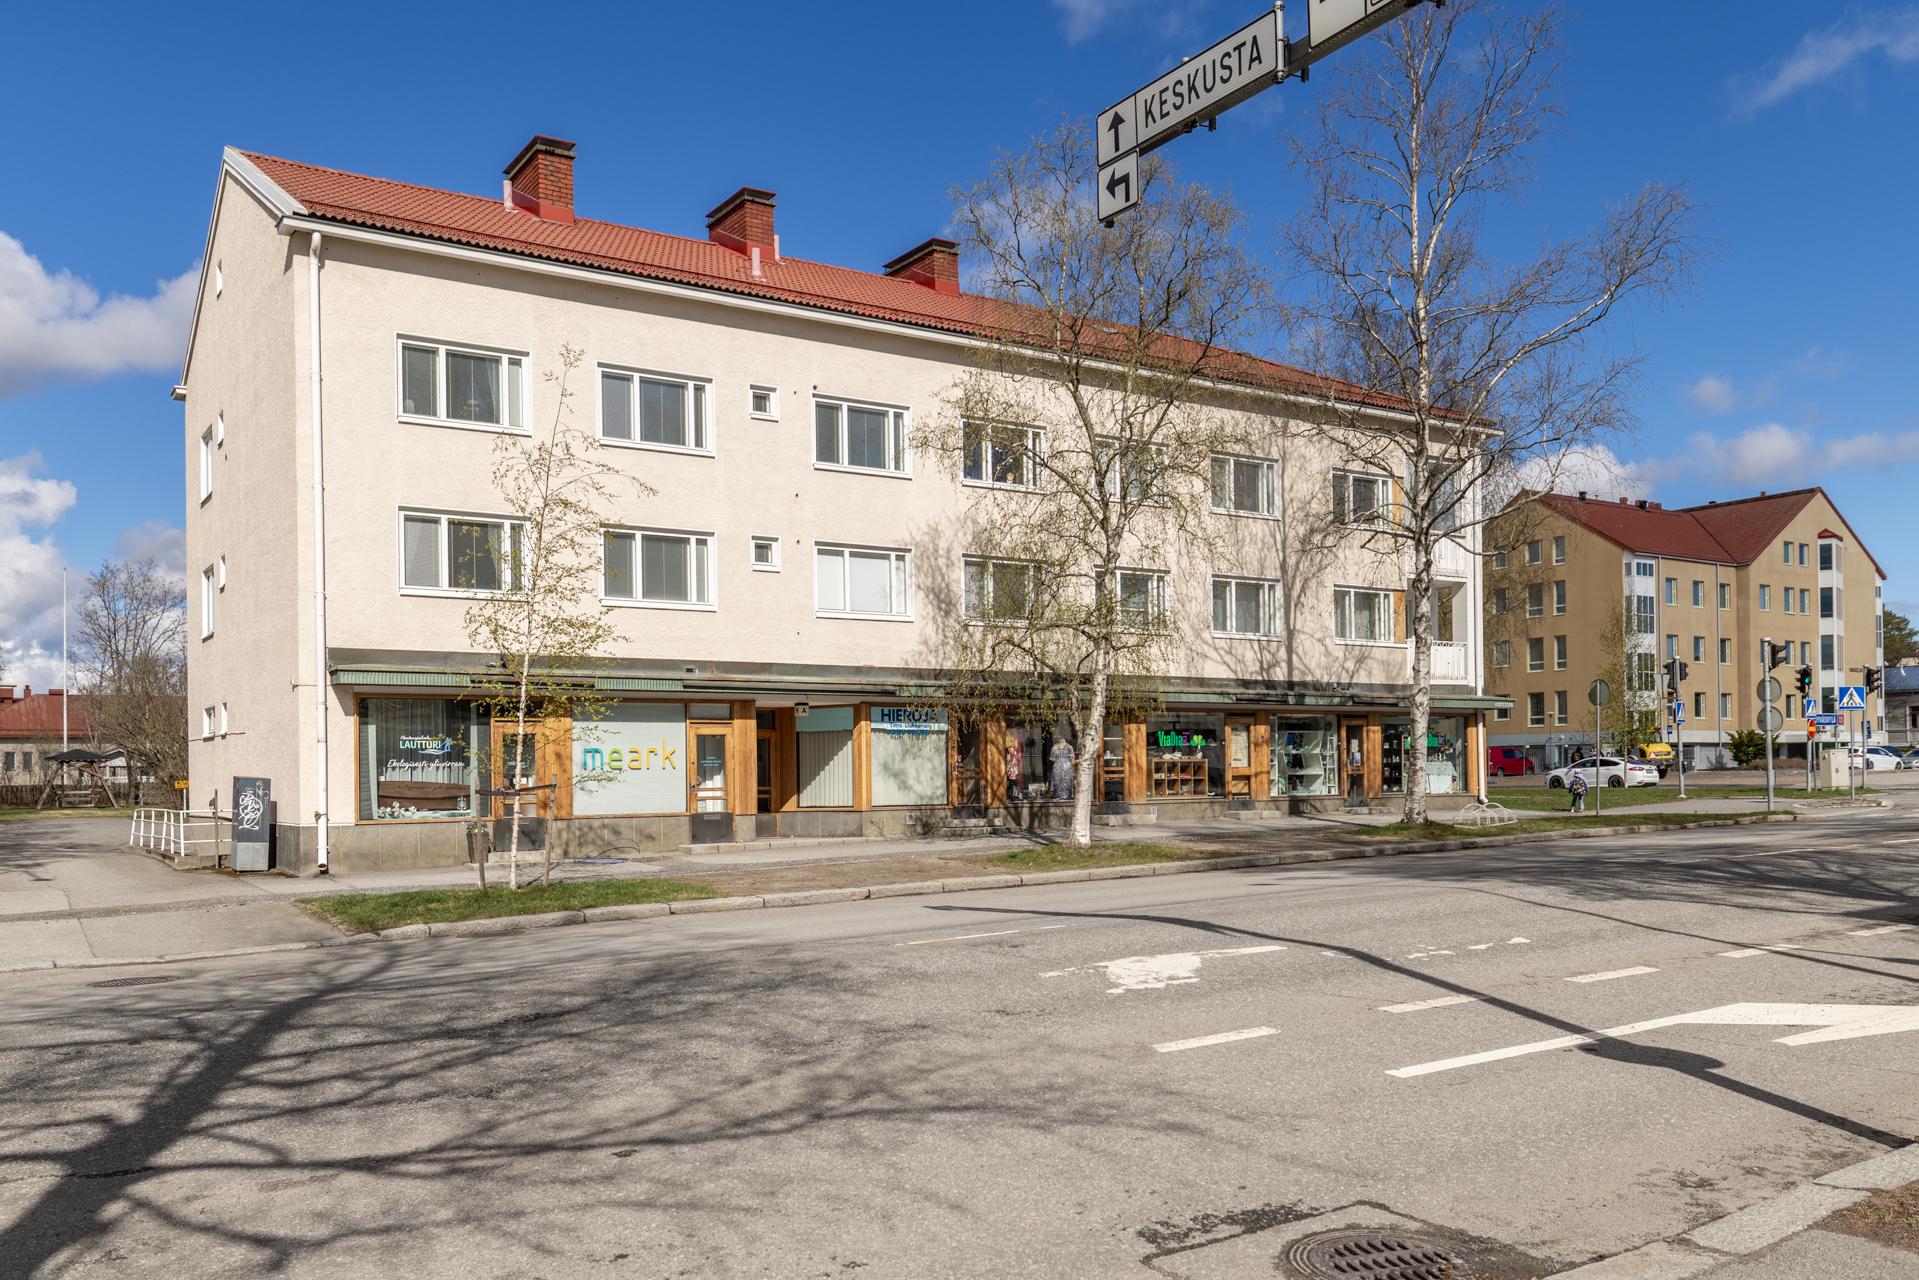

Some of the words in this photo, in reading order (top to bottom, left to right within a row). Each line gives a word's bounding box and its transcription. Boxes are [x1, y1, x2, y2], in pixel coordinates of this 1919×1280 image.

[1144, 34, 1262, 128] KESKUSTA
[400, 740, 441, 749] LAUTTURI
[1158, 731, 1183, 746] ViaDia
[583, 738, 676, 770] meark
